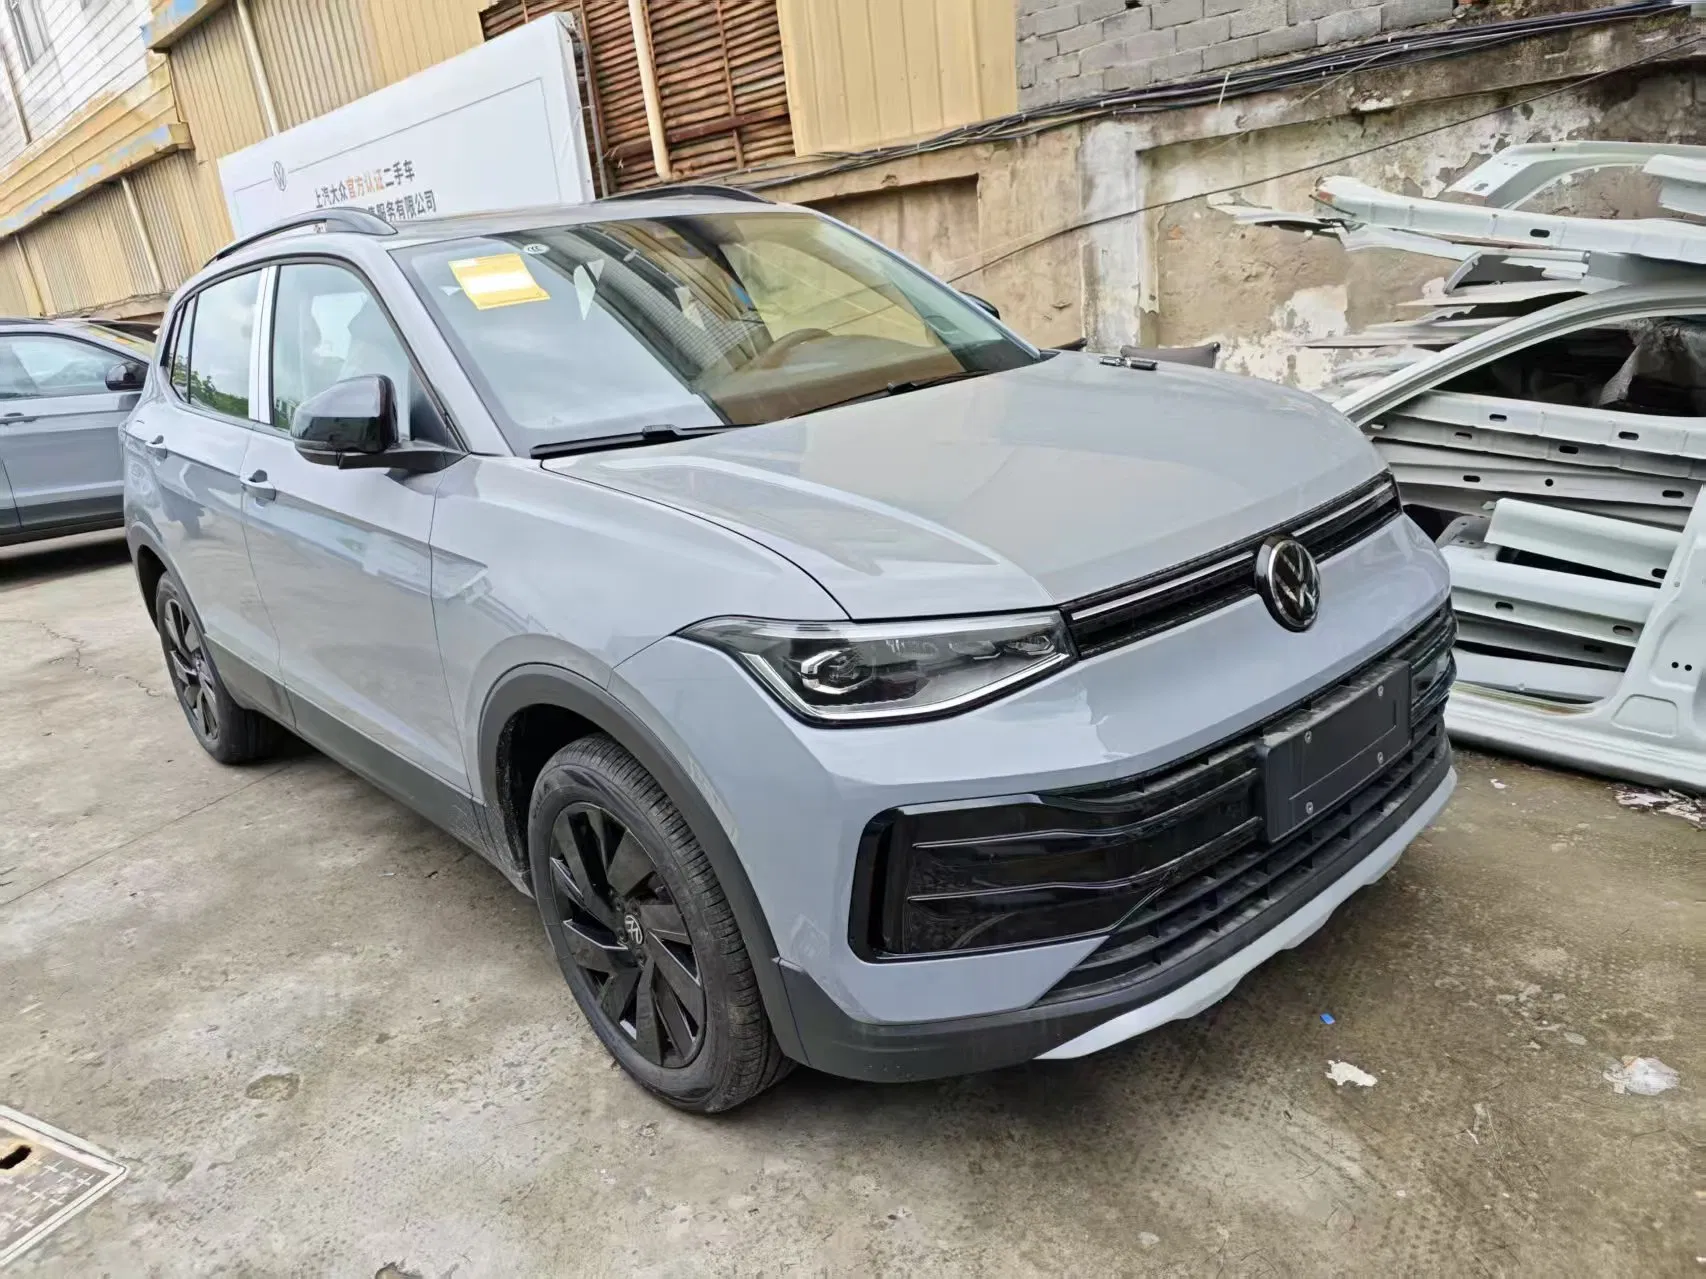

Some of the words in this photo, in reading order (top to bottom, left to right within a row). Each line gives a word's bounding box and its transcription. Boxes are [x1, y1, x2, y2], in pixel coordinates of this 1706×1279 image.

[315, 160, 415, 209] 上汽大众官方认证二手车
